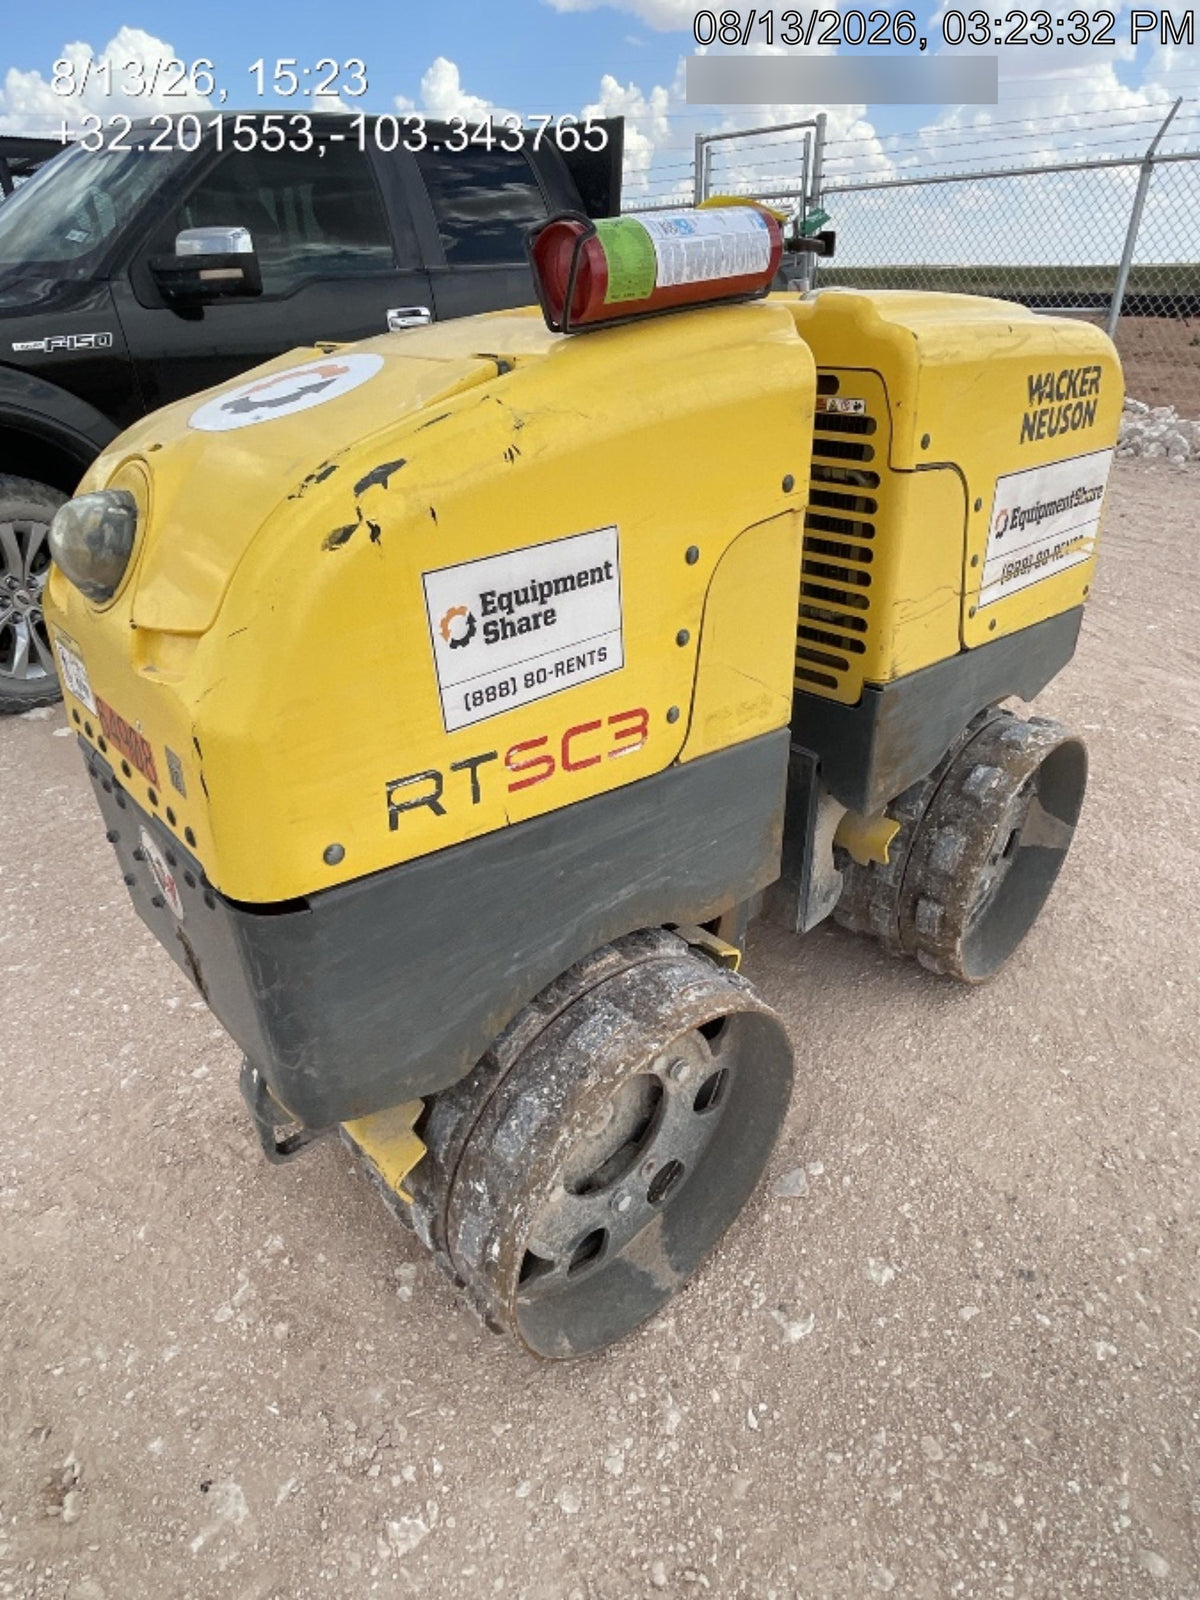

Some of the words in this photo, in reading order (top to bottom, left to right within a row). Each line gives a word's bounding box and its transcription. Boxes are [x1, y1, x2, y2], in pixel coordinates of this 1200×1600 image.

[1027, 365, 1101, 407] WACKER
[1019, 398, 1098, 445] NEUSON
[479, 560, 614, 617] Equipment
[483, 607, 558, 645] Share
[464, 677, 518, 712] (888)
[524, 646, 608, 689] 80-RENTS
[385, 707, 650, 832] RTSC3
